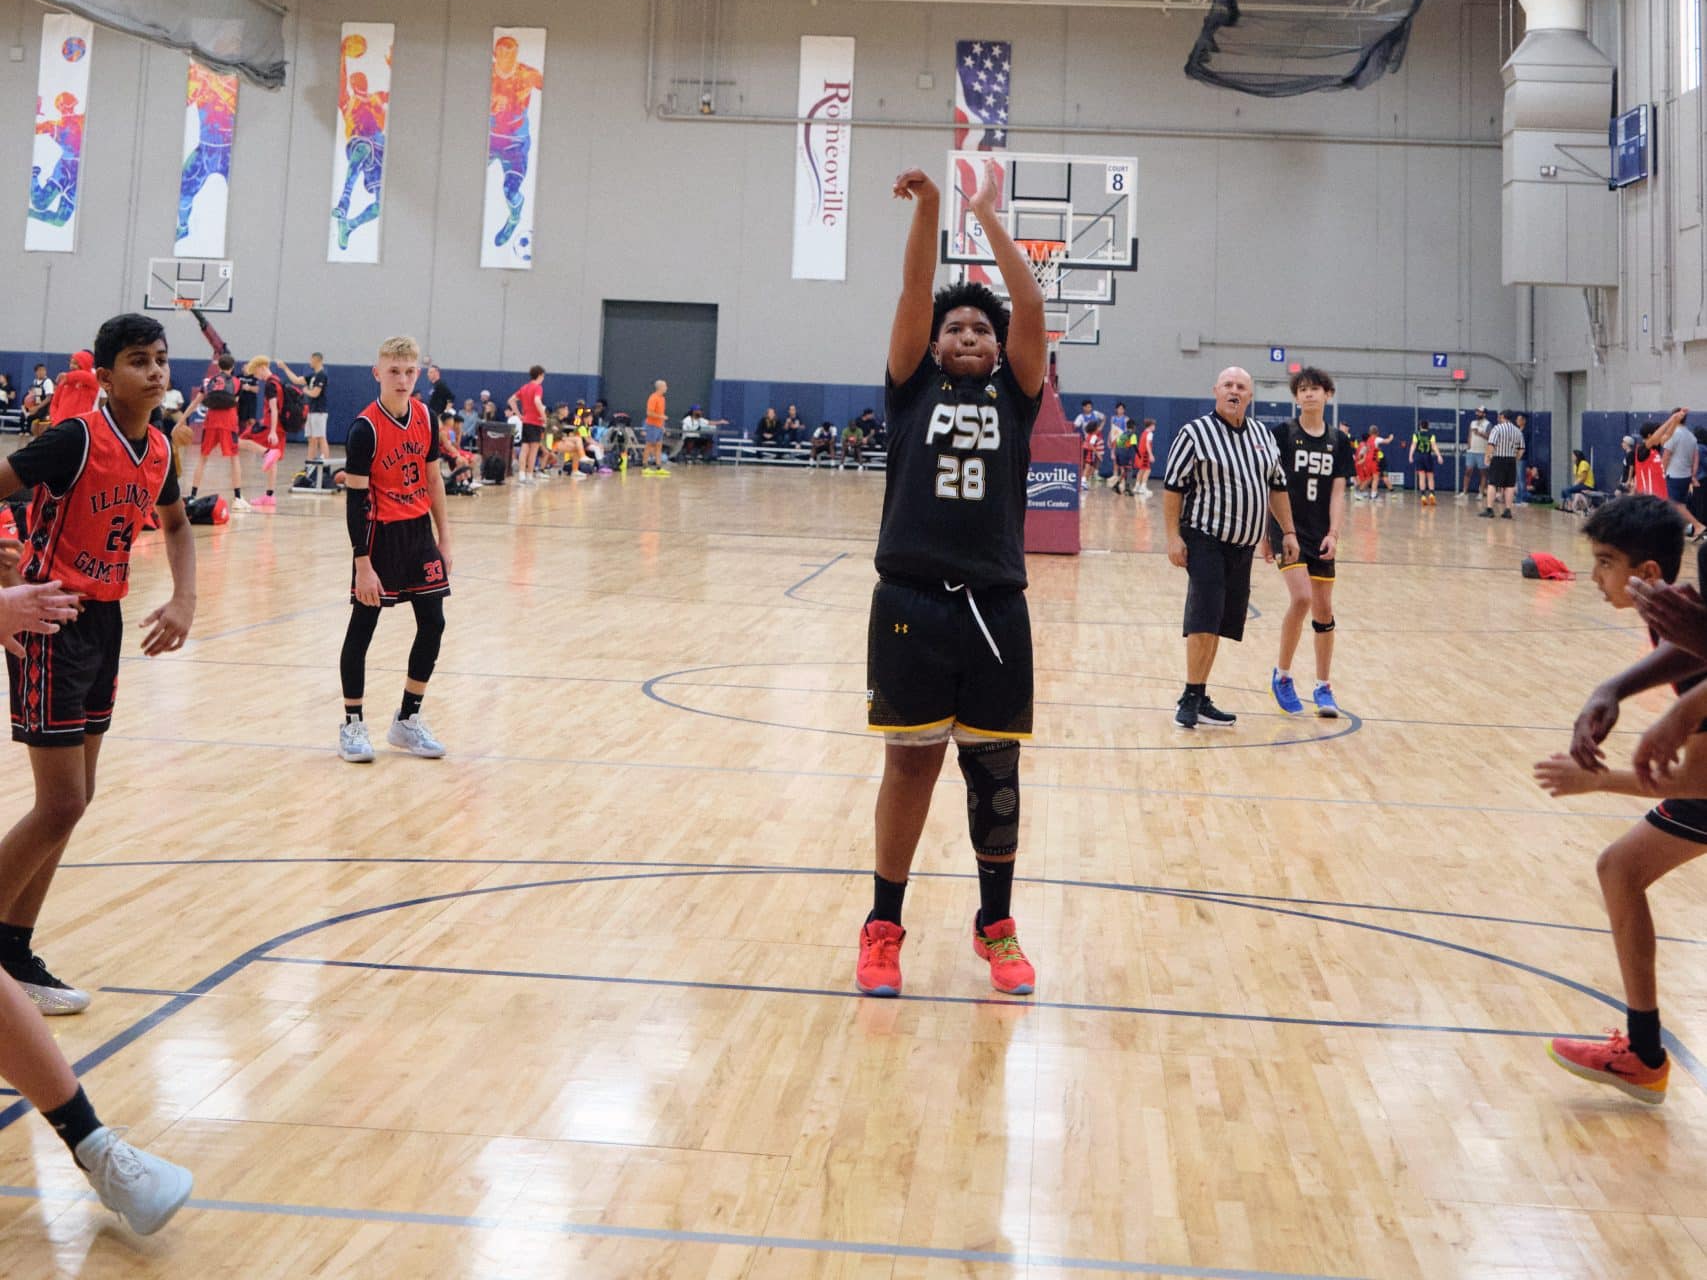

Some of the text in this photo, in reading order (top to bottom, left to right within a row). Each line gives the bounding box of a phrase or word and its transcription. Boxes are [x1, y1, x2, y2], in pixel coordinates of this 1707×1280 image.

[803, 80, 850, 227] Romeoville
[1113, 173, 1123, 191] 8
[974, 223, 982, 237] 5
[1273, 349, 1282, 360] 6
[1435, 355, 1445, 366] 7
[925, 403, 1000, 450] PSB
[401, 462, 419, 487] 33
[1294, 450, 1334, 476] PSB
[936, 455, 985, 500] 28
[1027, 468, 1077, 482] eoville
[1307, 478, 1318, 501] 6
[106, 515, 134, 552] 24
[423, 560, 443, 582] 33
